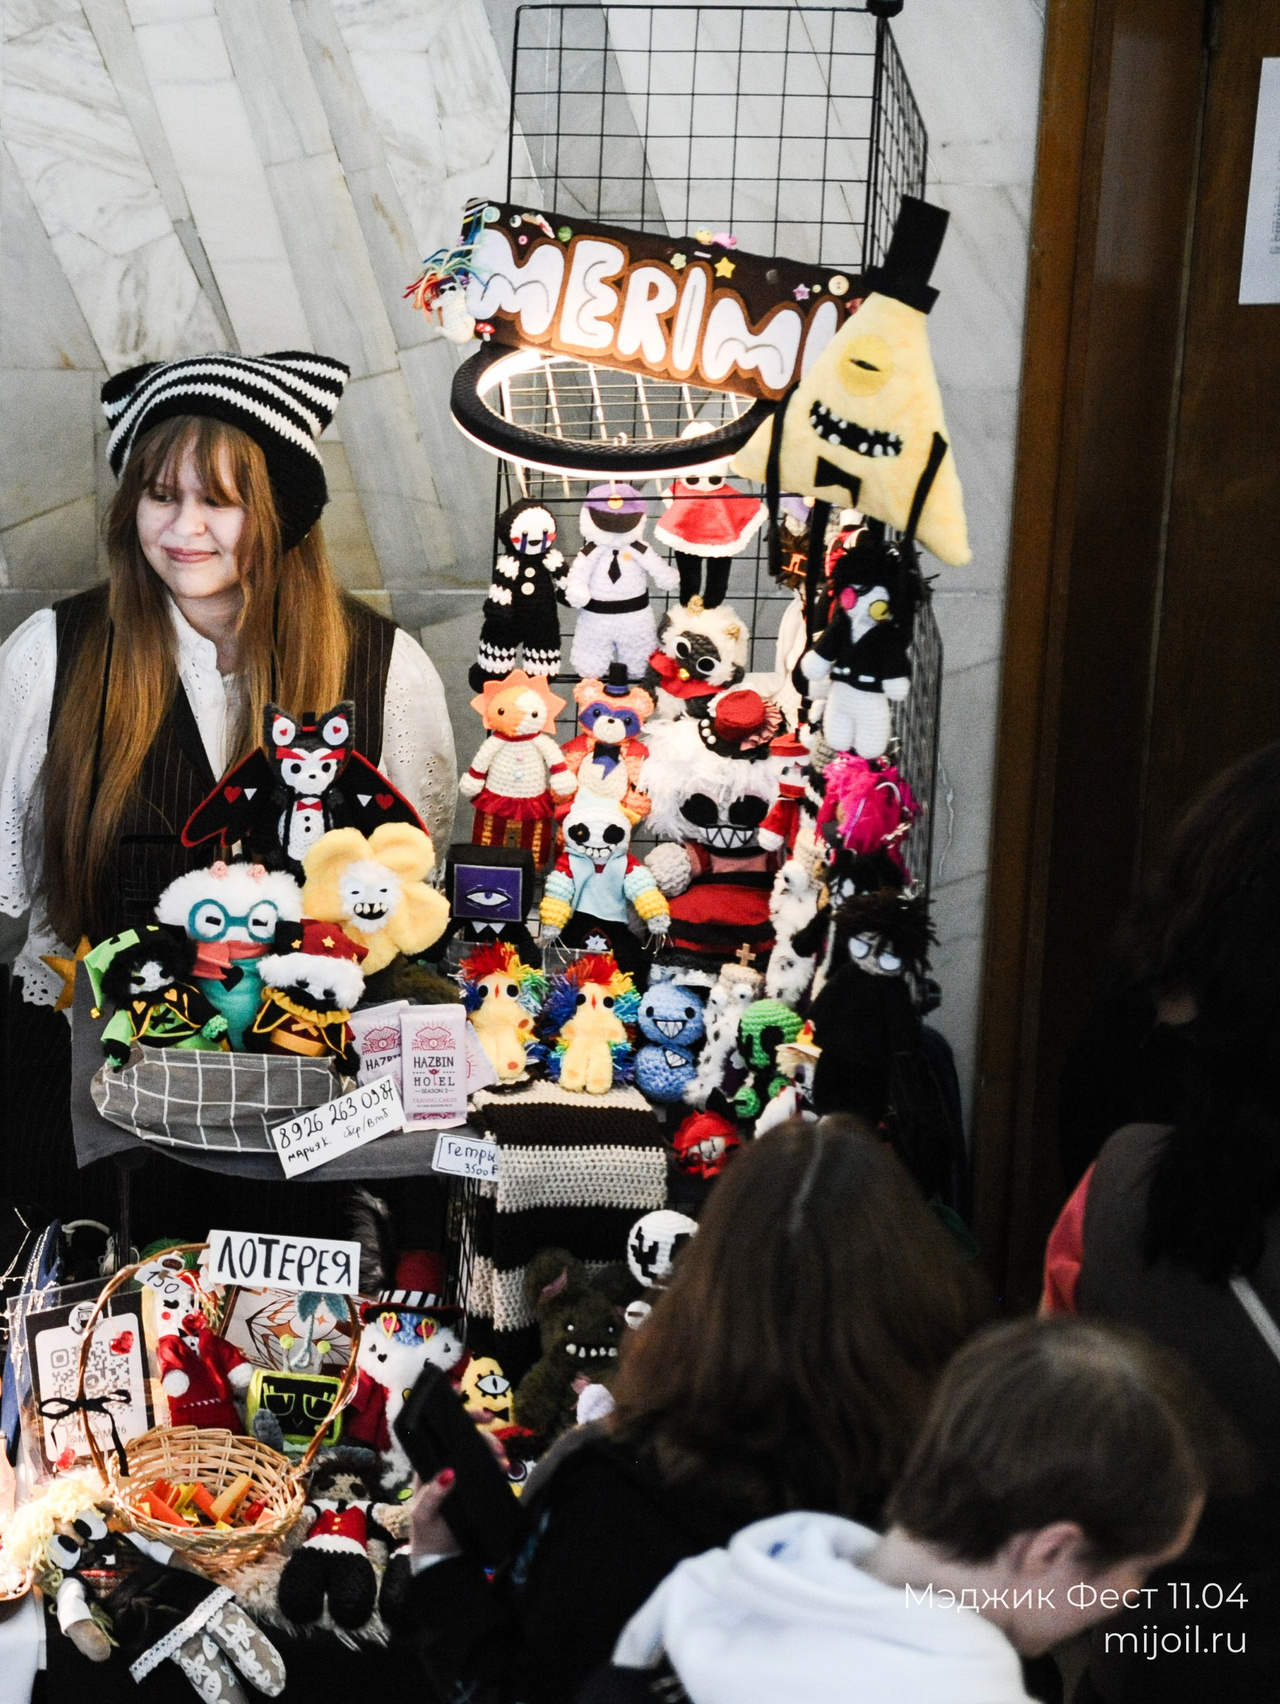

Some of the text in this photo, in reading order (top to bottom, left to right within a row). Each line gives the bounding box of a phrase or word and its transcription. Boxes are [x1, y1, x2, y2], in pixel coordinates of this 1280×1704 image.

[413, 1056, 454, 1068] HAZBIN
[280, 1113, 323, 1149] 8926
[329, 1097, 357, 1126] 263
[448, 1142, 496, 1166] Гетры
[217, 1235, 352, 1287] ЛОТЕРЕЯ
